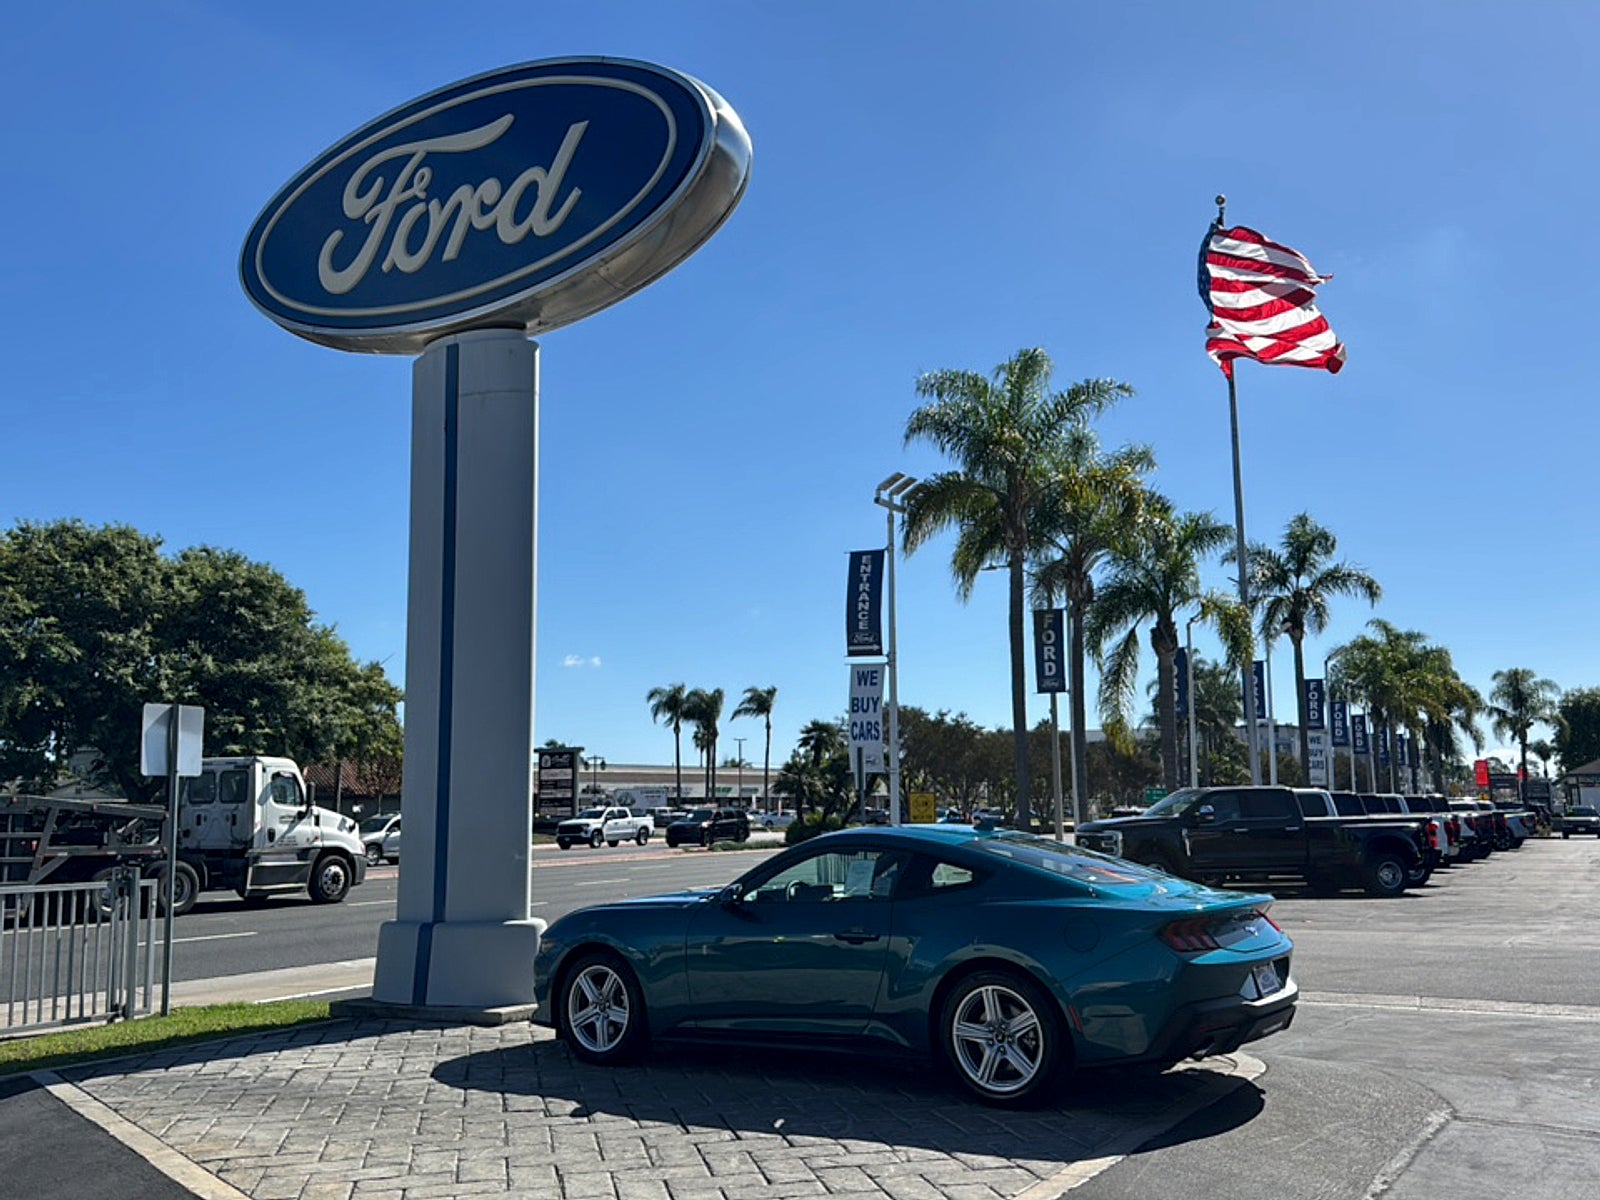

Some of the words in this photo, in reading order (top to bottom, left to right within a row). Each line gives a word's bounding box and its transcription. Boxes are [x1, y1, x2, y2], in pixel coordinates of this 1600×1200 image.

[318, 113, 590, 294] Ford
[858, 554, 872, 630] ENTRANCE
[1041, 613, 1057, 677] FORD
[857, 670, 878, 686] WE
[851, 697, 880, 713] BUY
[1308, 682, 1318, 720] FORD
[851, 721, 880, 741] CARS
[1333, 703, 1343, 736] FORD
